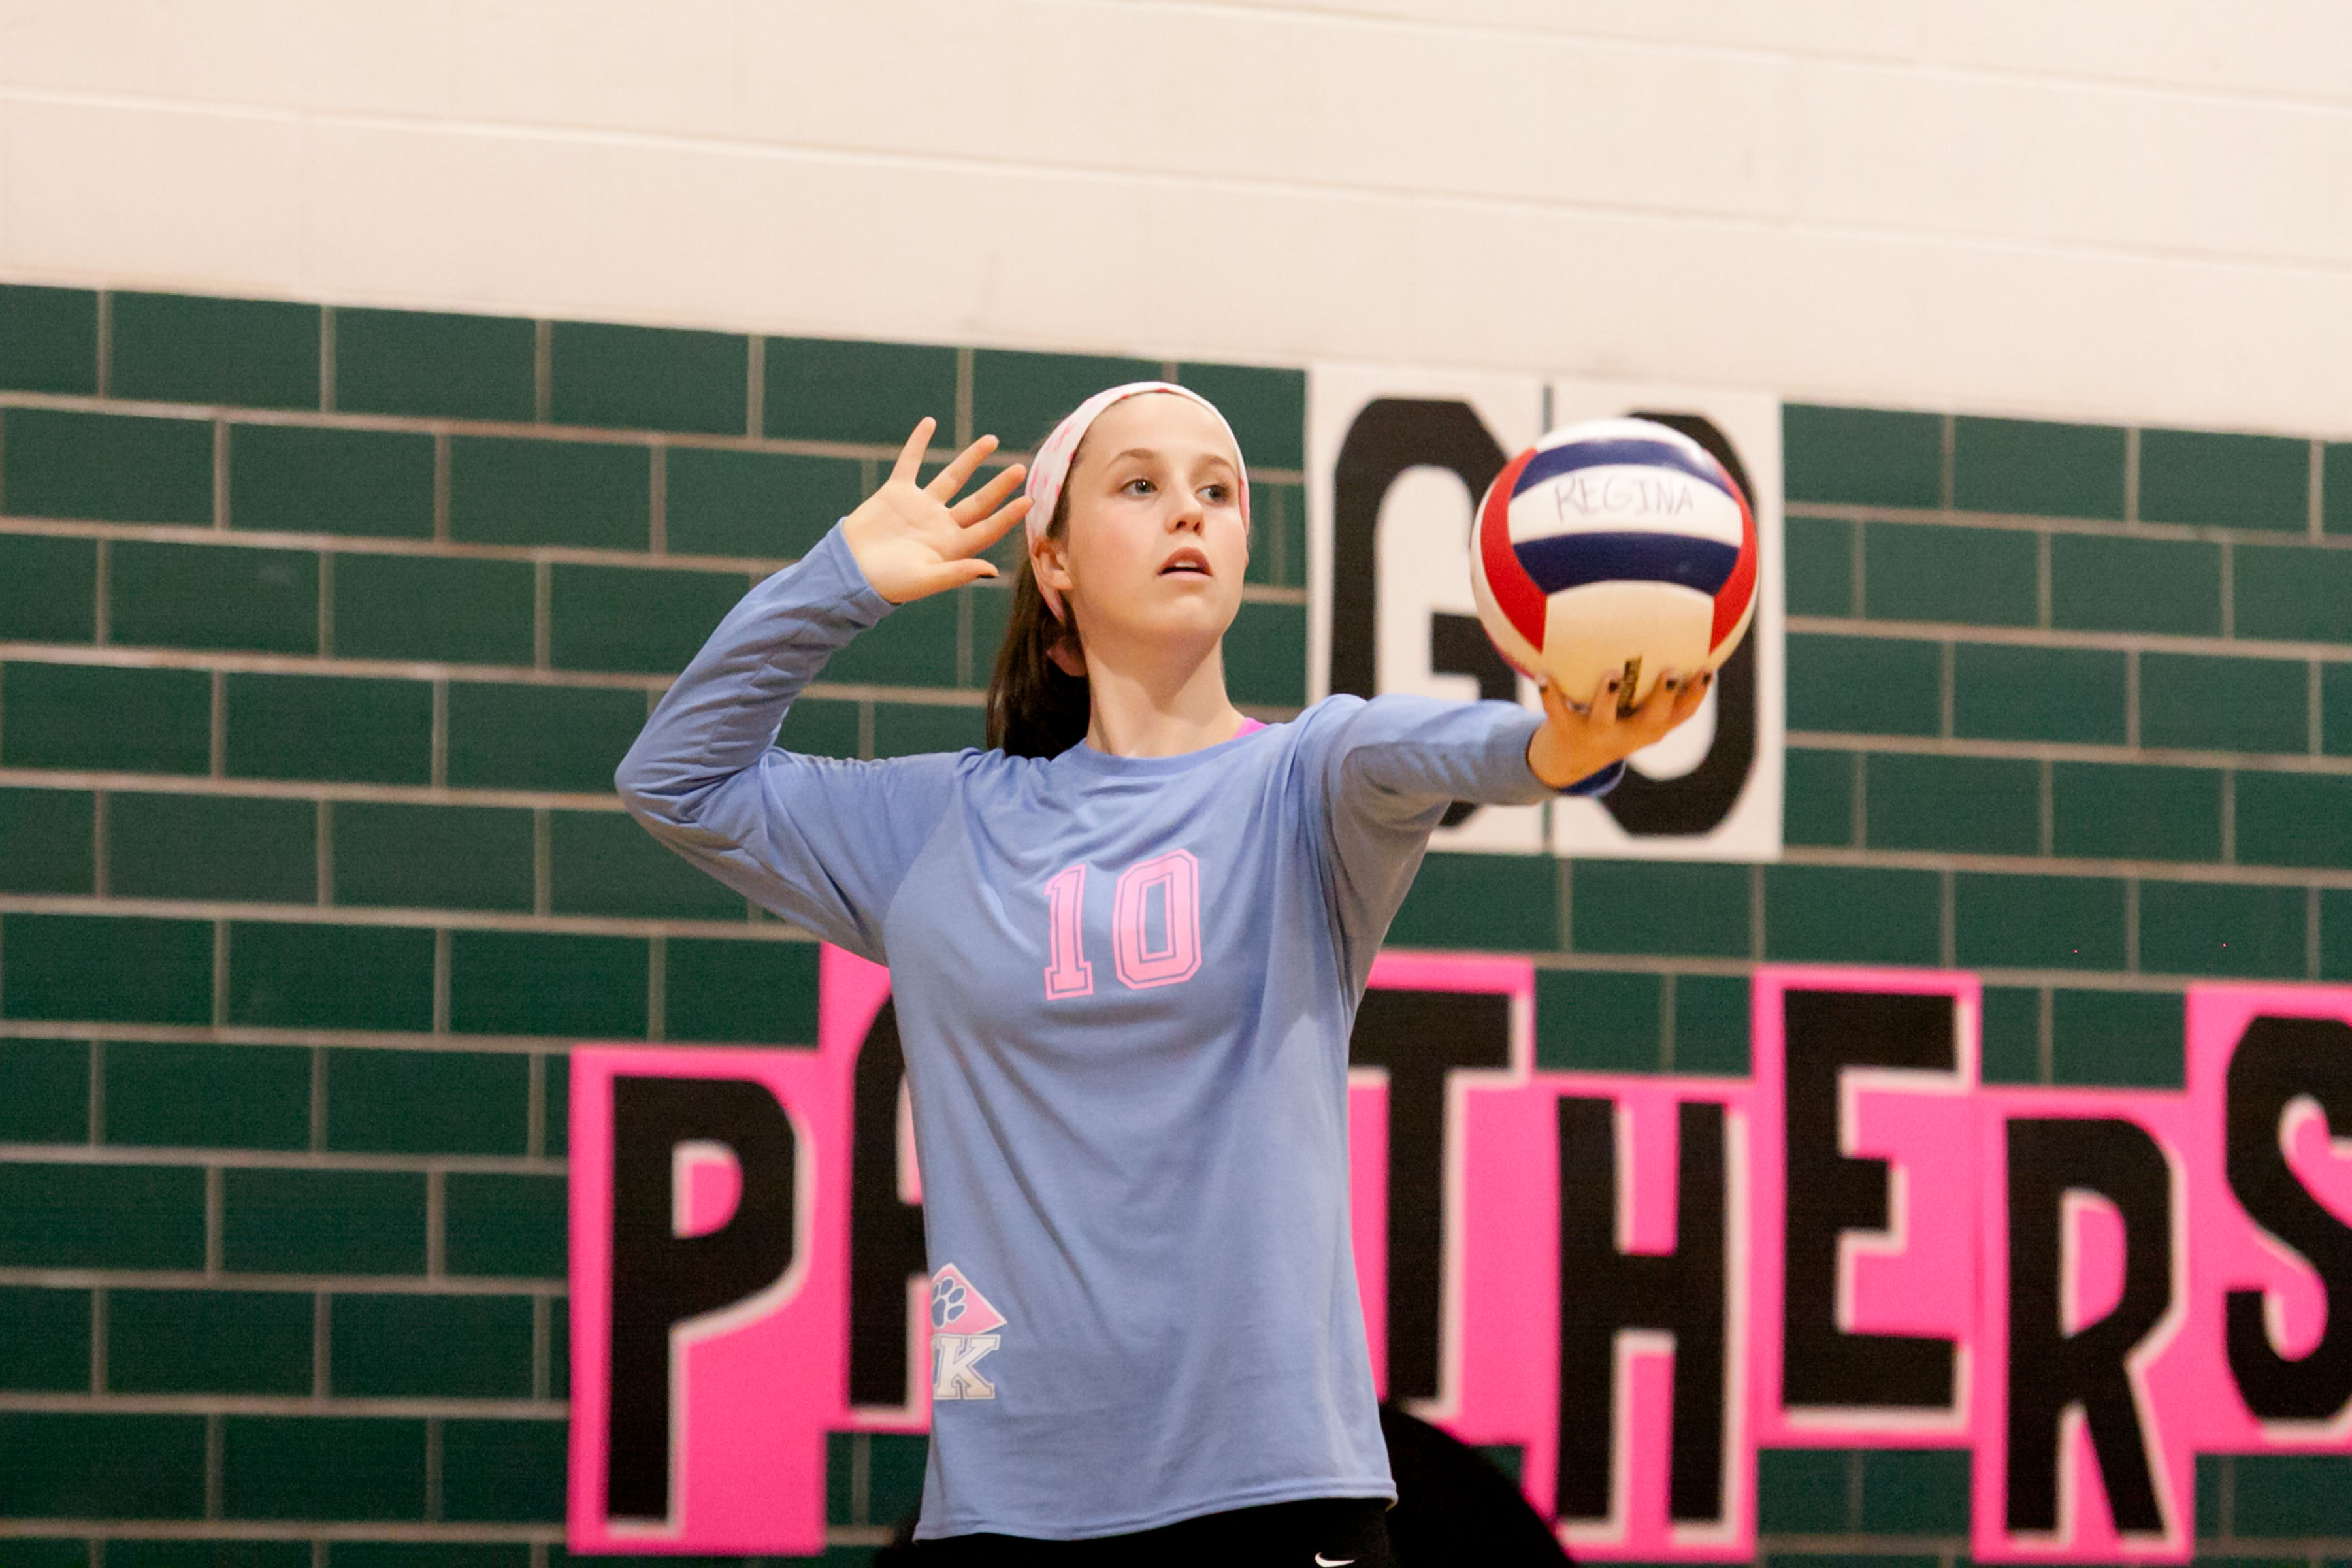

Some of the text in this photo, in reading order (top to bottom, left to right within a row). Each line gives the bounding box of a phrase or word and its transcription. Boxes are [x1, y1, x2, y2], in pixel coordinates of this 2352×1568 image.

[1554, 474, 1694, 523] REGINA
[1045, 849, 1201, 1000] 10
[604, 987, 2352, 1537] PTHERS
